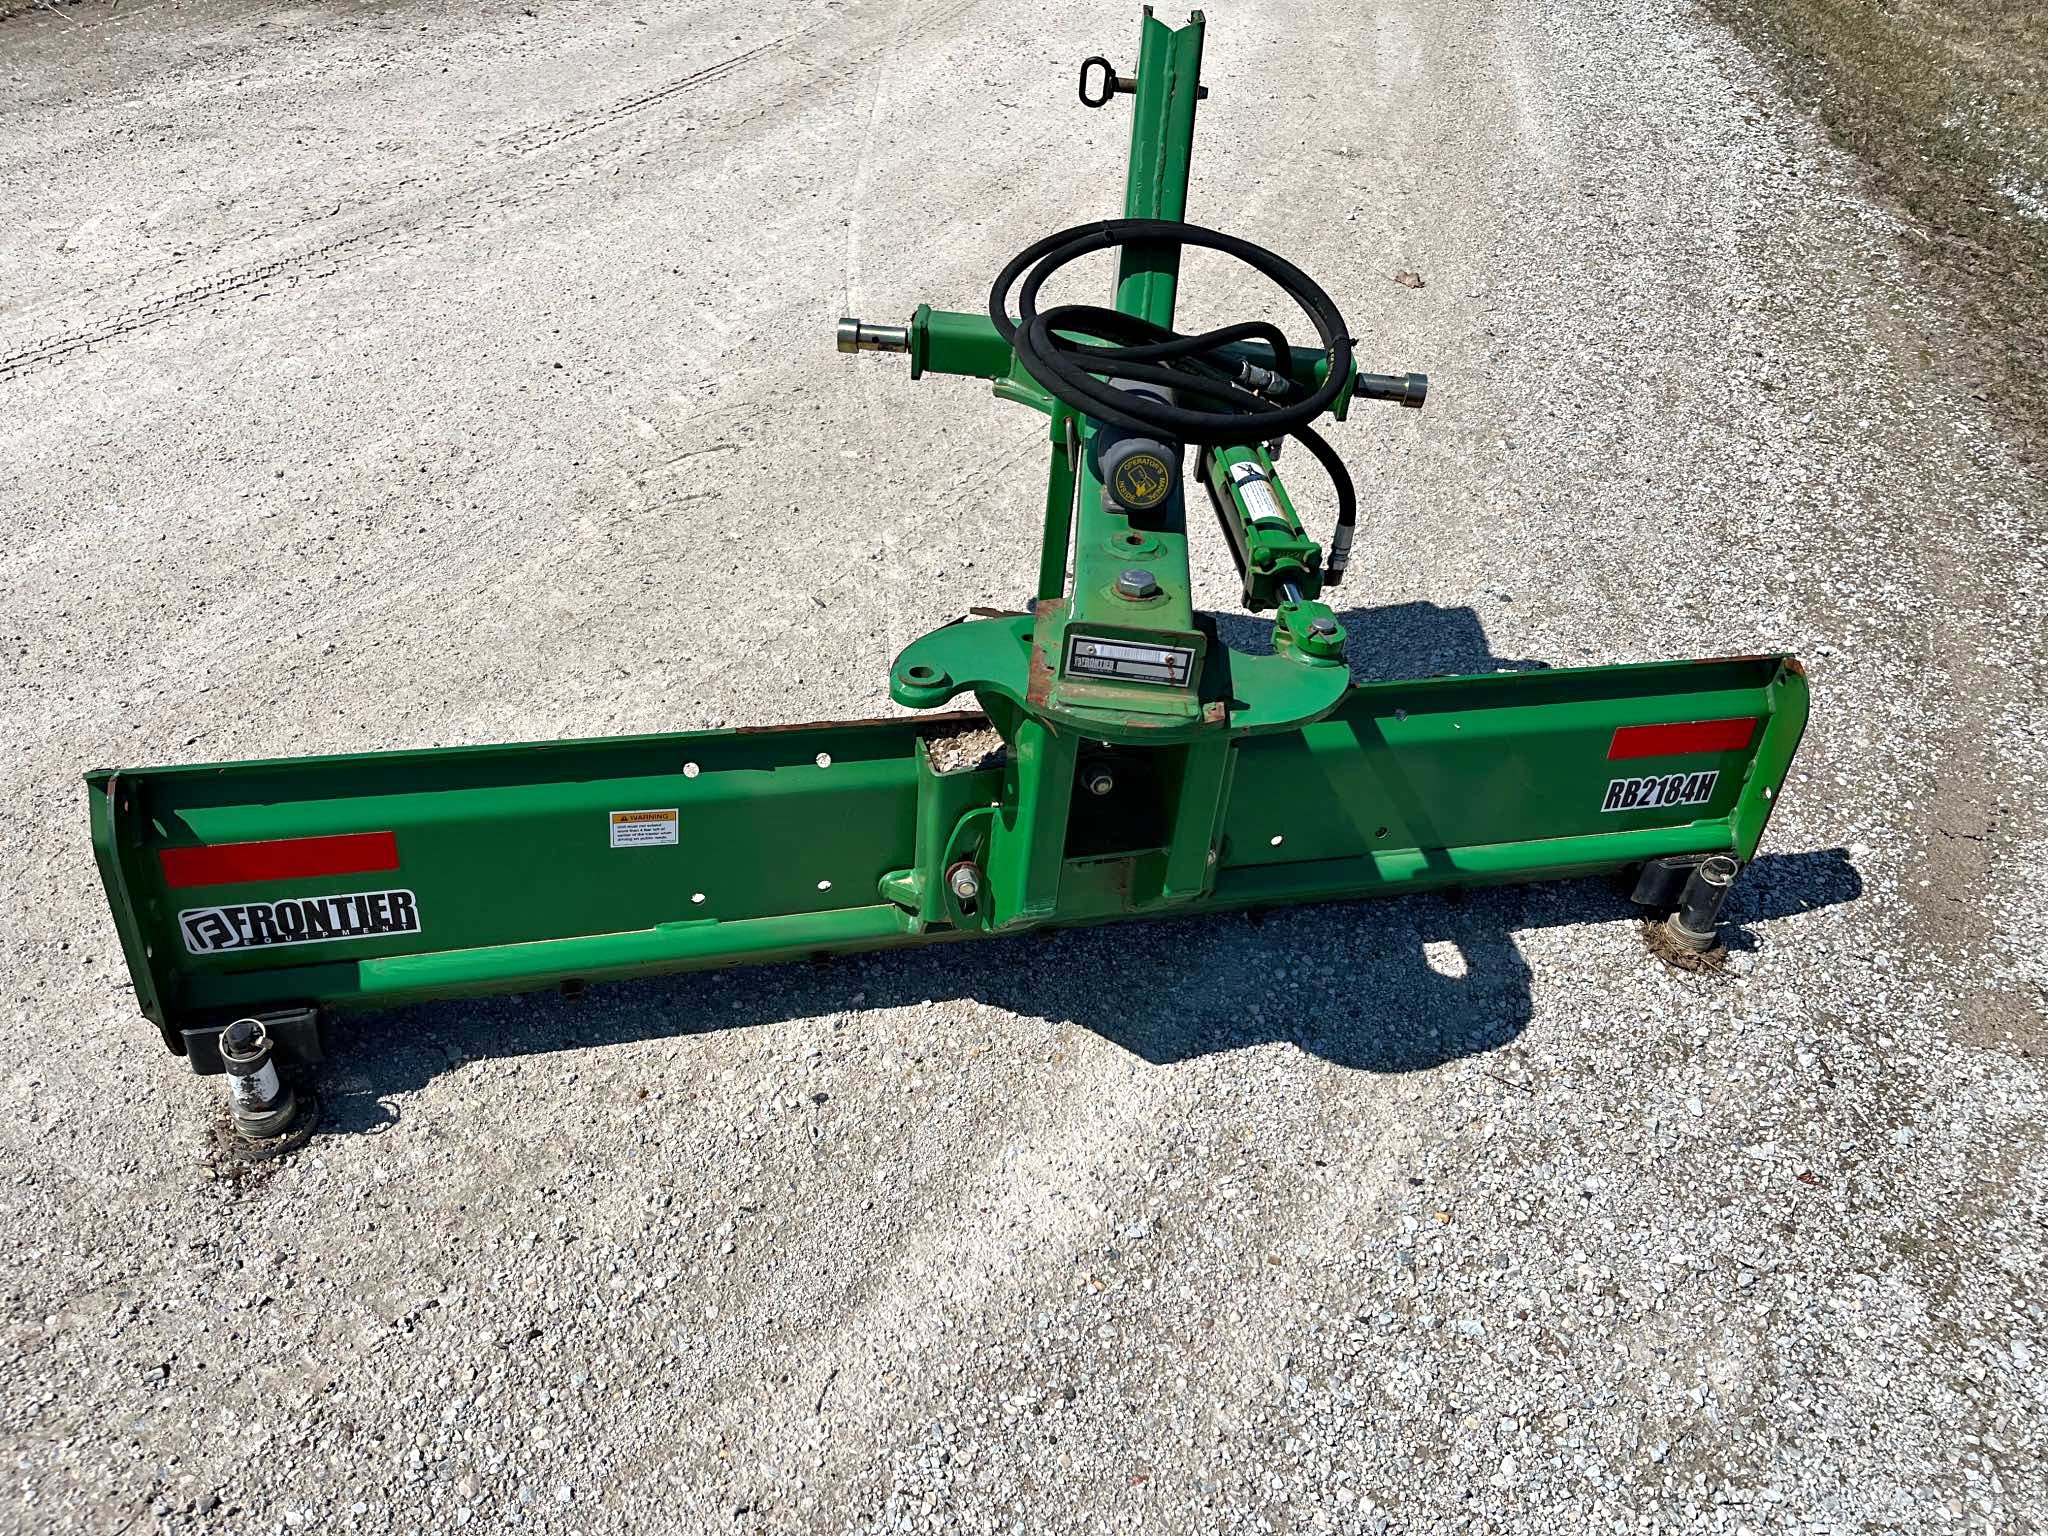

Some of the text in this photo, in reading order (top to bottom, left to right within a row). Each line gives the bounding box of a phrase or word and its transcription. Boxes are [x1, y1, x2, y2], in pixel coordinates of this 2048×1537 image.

[1124, 458, 1163, 474] OPERATOR'S
[1603, 773, 1718, 810] RB2184H
[225, 891, 418, 939] FRONTIER
[243, 921, 408, 946] EQUIPMENT
